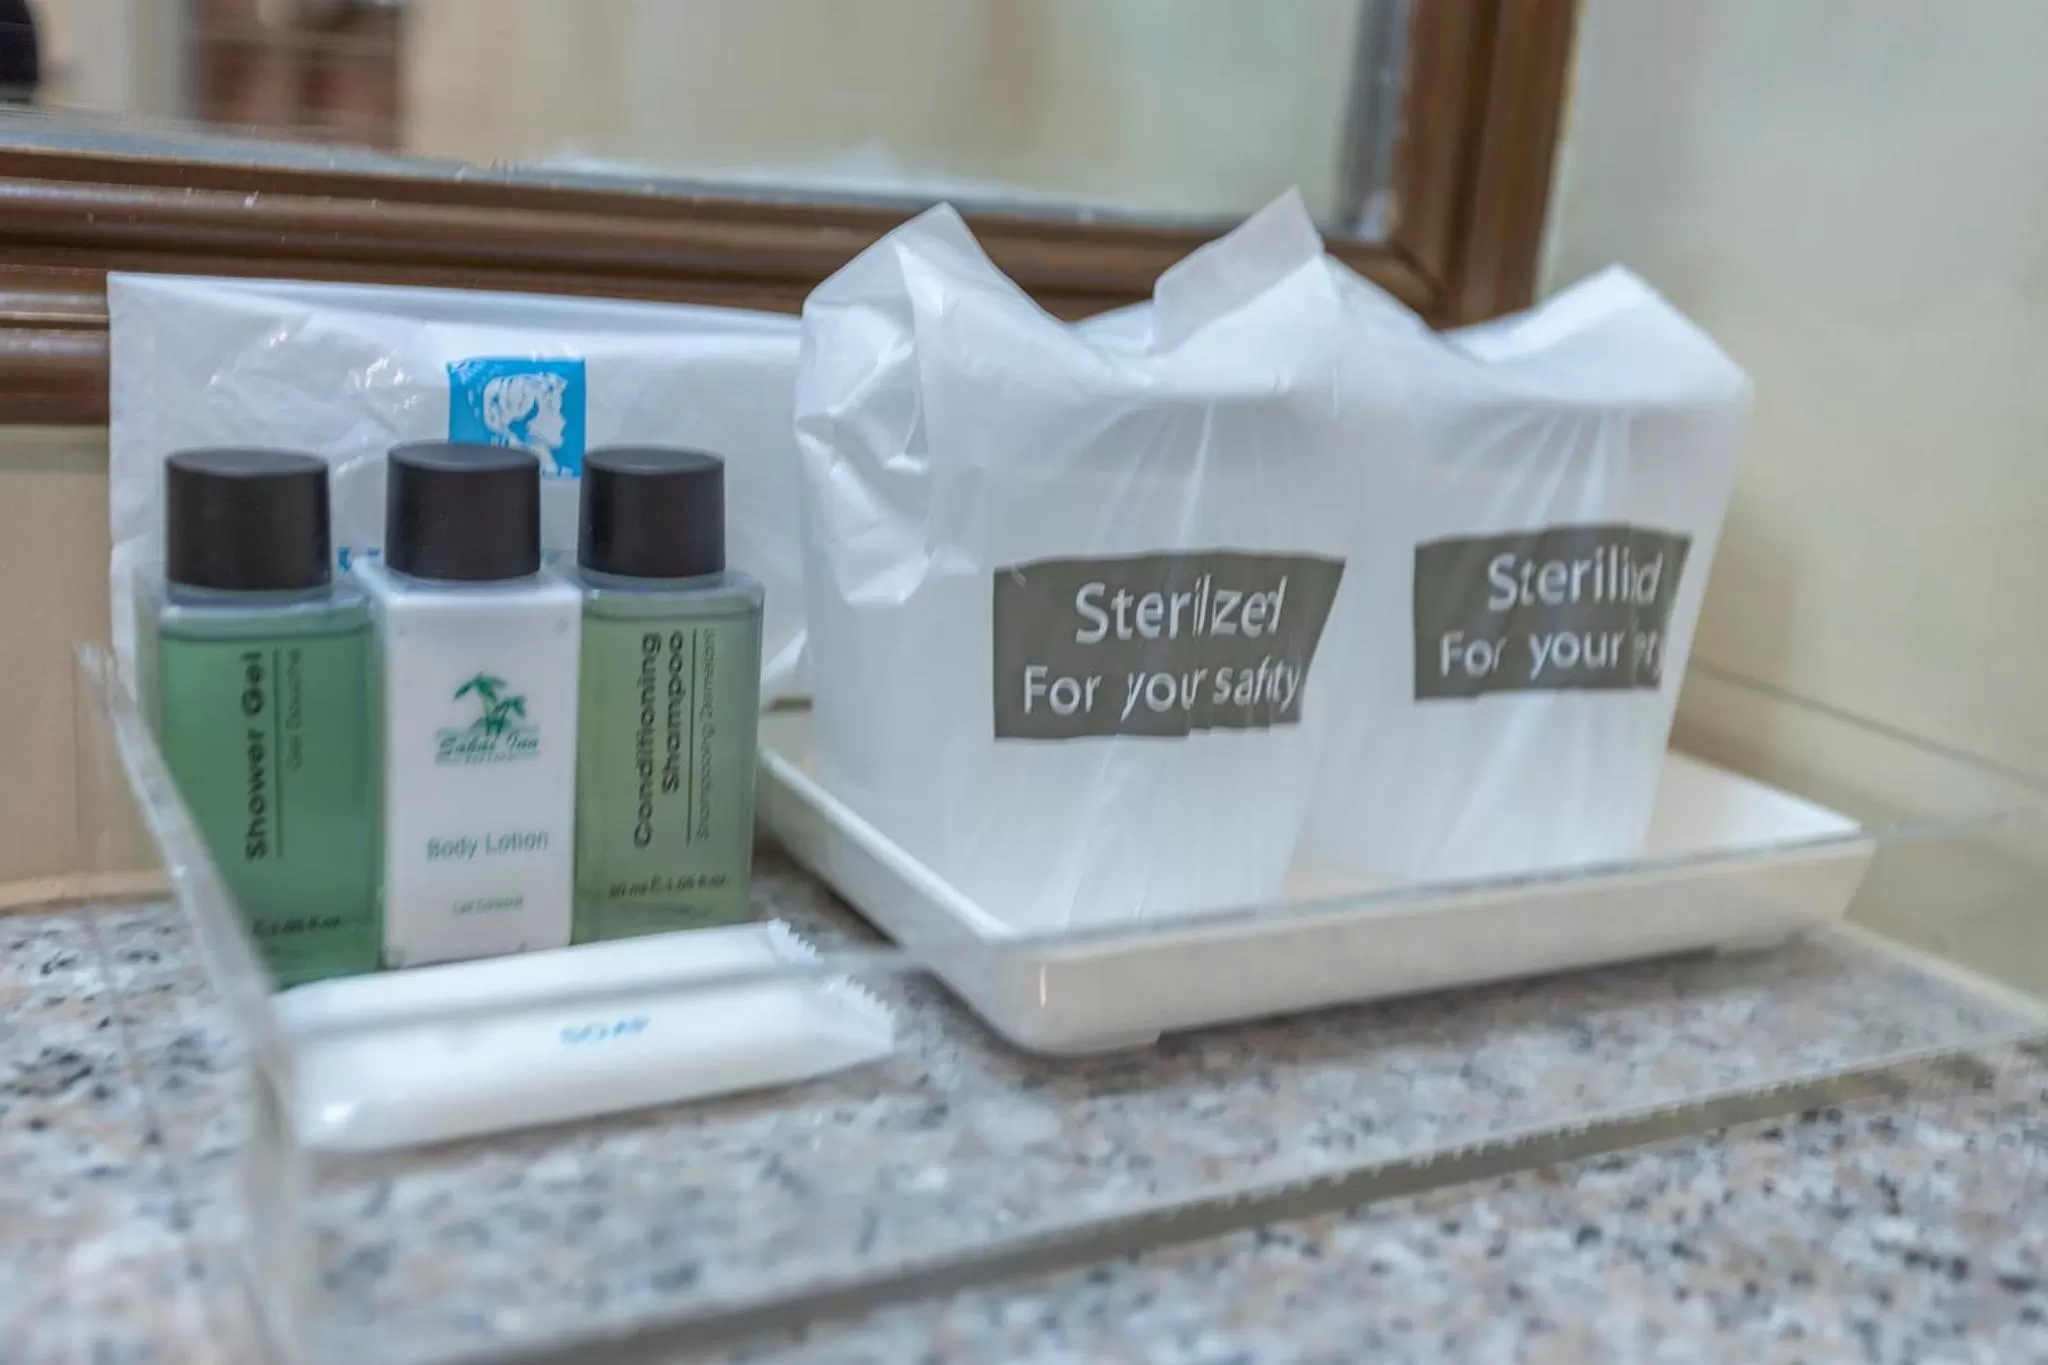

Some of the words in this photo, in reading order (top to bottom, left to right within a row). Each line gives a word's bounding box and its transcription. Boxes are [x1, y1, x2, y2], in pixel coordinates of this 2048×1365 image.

[240, 651, 266, 718] Gel
[1439, 629, 1507, 678] For
[1528, 629, 1625, 682] your
[661, 629, 686, 795] Shampoo
[1023, 664, 1102, 716] For
[1120, 667, 1208, 724] your
[633, 632, 662, 850] Conditioning
[244, 727, 268, 863] Shower
[426, 834, 479, 863] Body
[486, 830, 549, 857] Lotion
